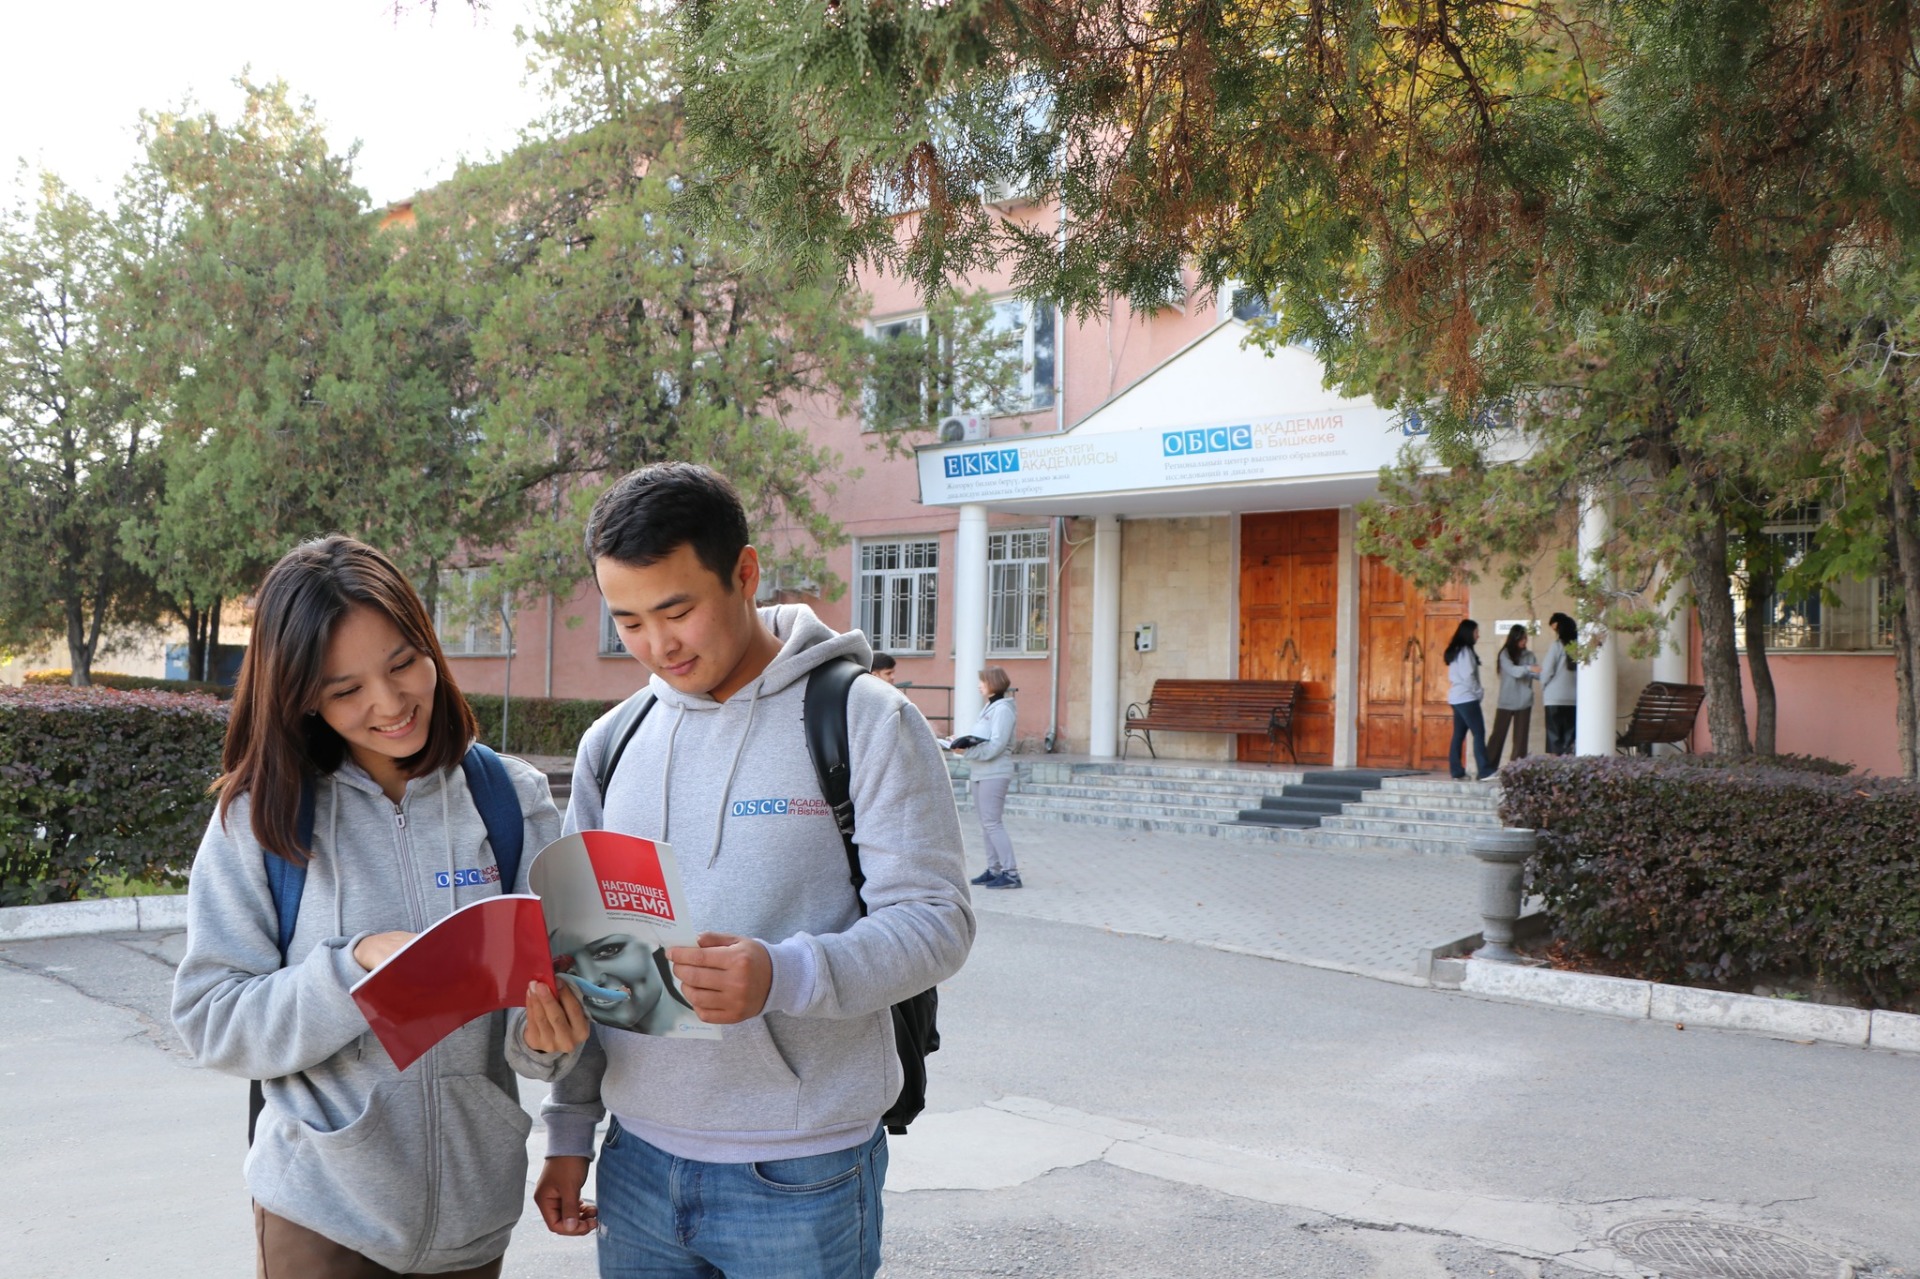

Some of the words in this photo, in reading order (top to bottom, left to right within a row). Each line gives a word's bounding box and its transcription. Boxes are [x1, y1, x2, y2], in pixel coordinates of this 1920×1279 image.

[1254, 415, 1344, 435] АКАДЕМИЯ
[1255, 440, 1263, 449] в
[1268, 432, 1336, 448] Бишкеке
[947, 451, 1017, 476] ЕККУ
[1020, 443, 1094, 459] Бишкектеги
[1022, 453, 1118, 471] АКАДЕМИЯСЫ
[1164, 459, 1223, 471] Региональный
[1224, 457, 1250, 466] центр
[1250, 454, 1288, 463] высшего
[797, 806, 830, 816] Bishkek
[601, 880, 666, 901] НАСТОЯЩЕЕ
[605, 891, 671, 917] ВРЕМЯ
